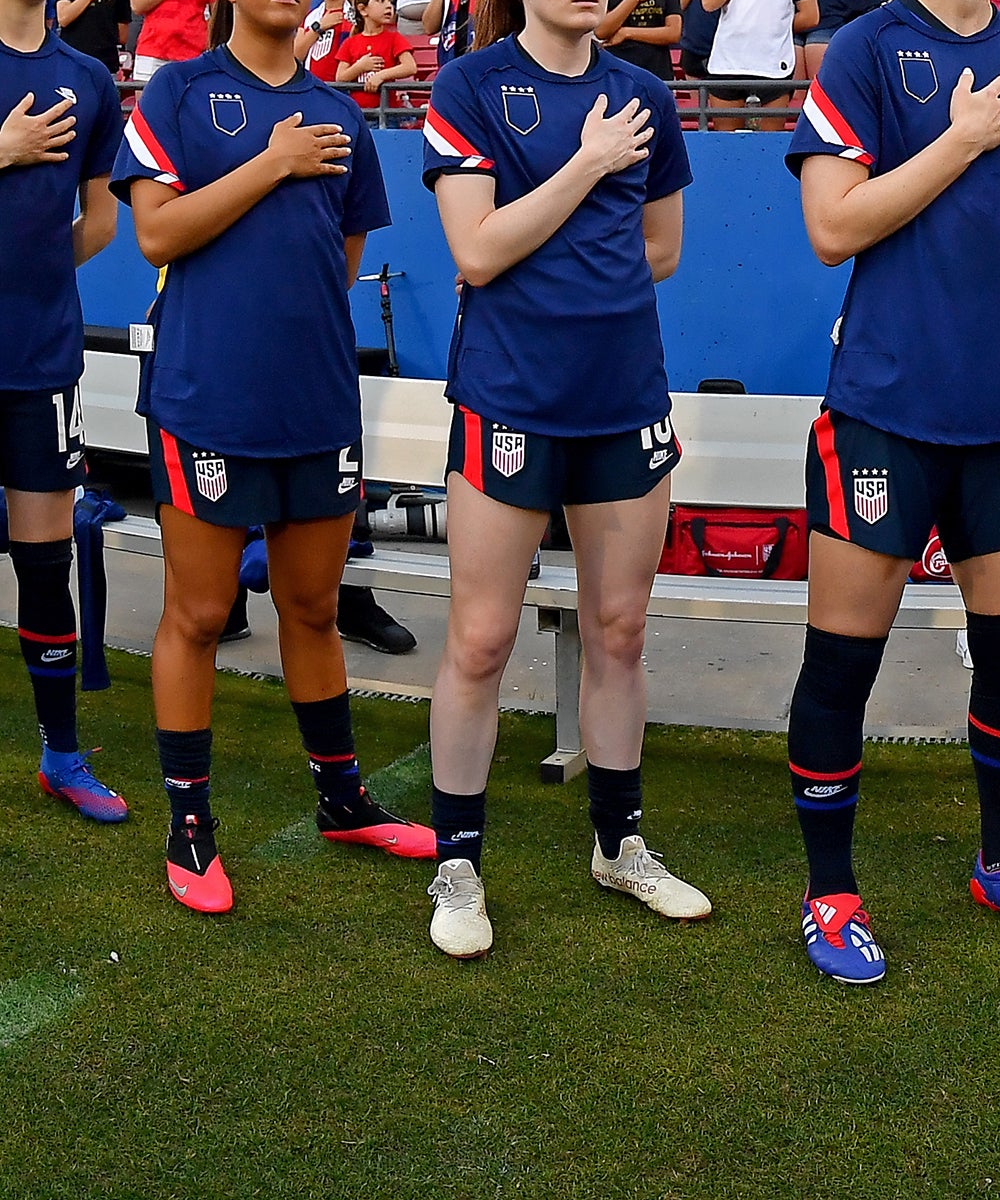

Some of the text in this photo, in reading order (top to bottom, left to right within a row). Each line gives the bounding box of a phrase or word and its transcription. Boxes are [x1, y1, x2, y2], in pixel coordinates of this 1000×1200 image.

[52, 385, 85, 452] 14
[495, 435, 523, 452] USA
[197, 461, 223, 478] USA
[857, 481, 885, 498] USA
[811, 784, 842, 794] NIKE
[607, 872, 657, 895] balance
